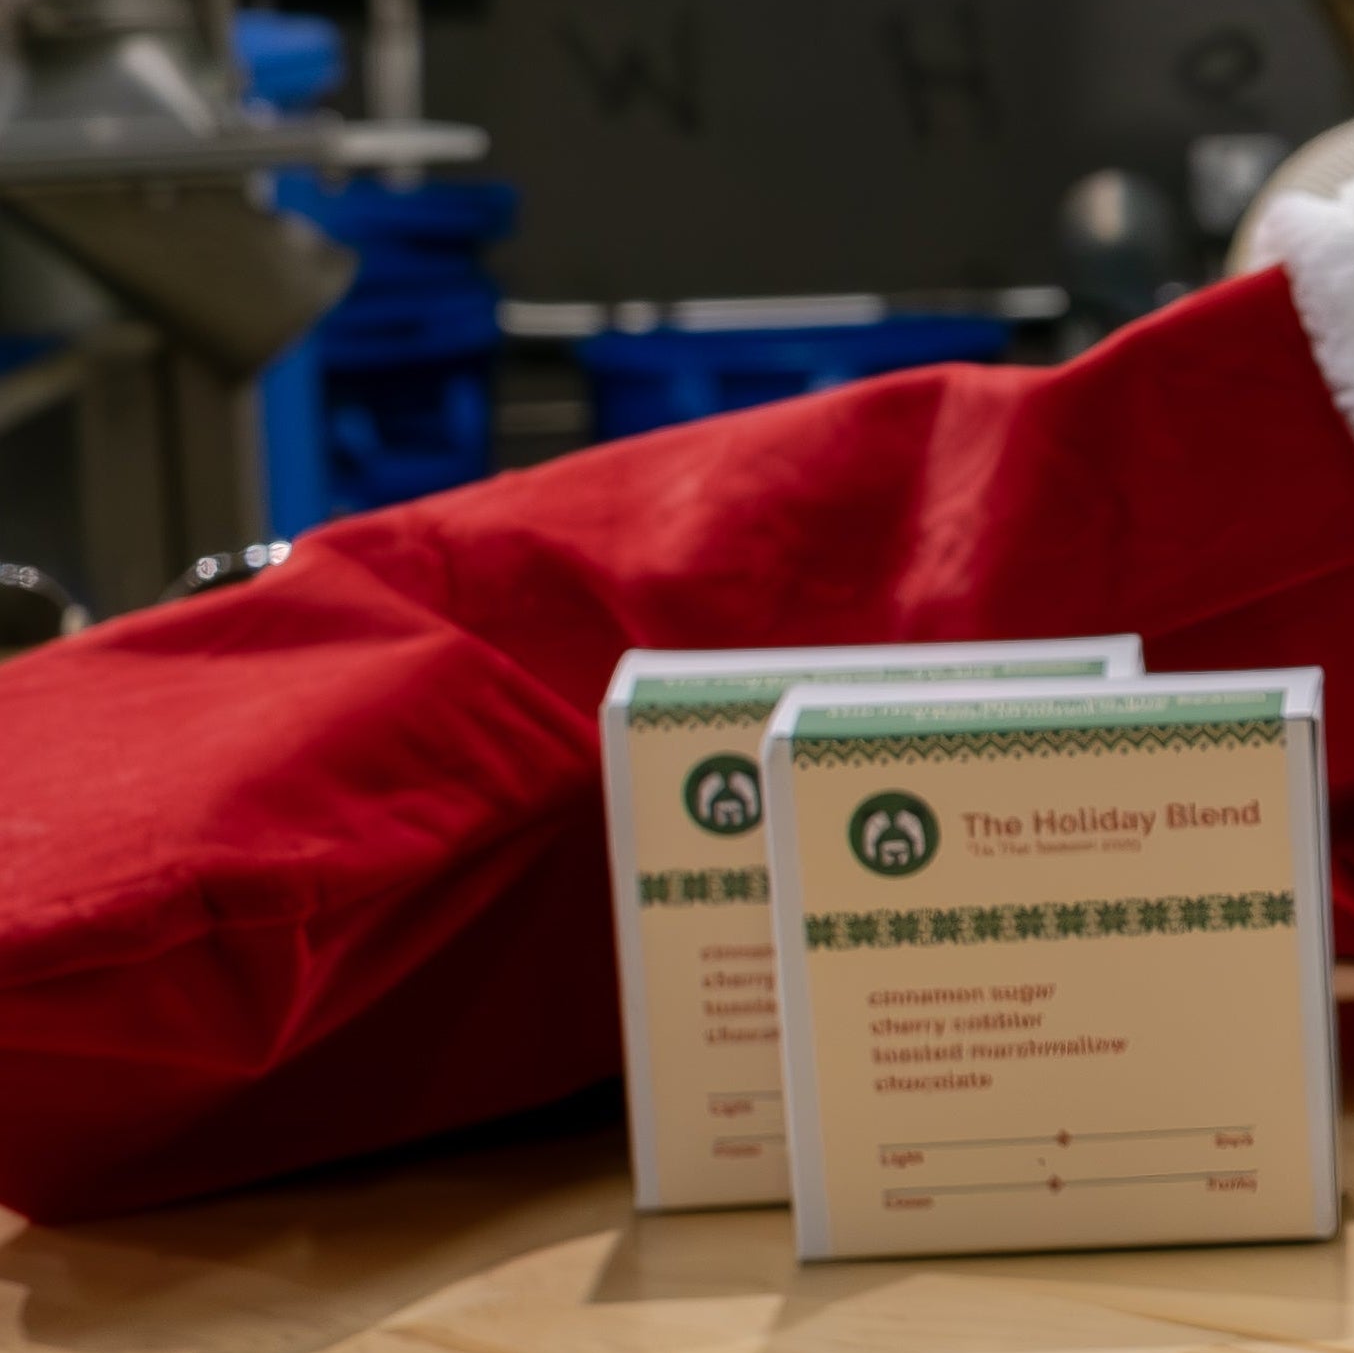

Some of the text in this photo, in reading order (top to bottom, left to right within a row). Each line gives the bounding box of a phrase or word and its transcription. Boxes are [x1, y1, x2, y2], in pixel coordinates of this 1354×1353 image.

[961, 802, 1260, 839] The Holiday Blend
